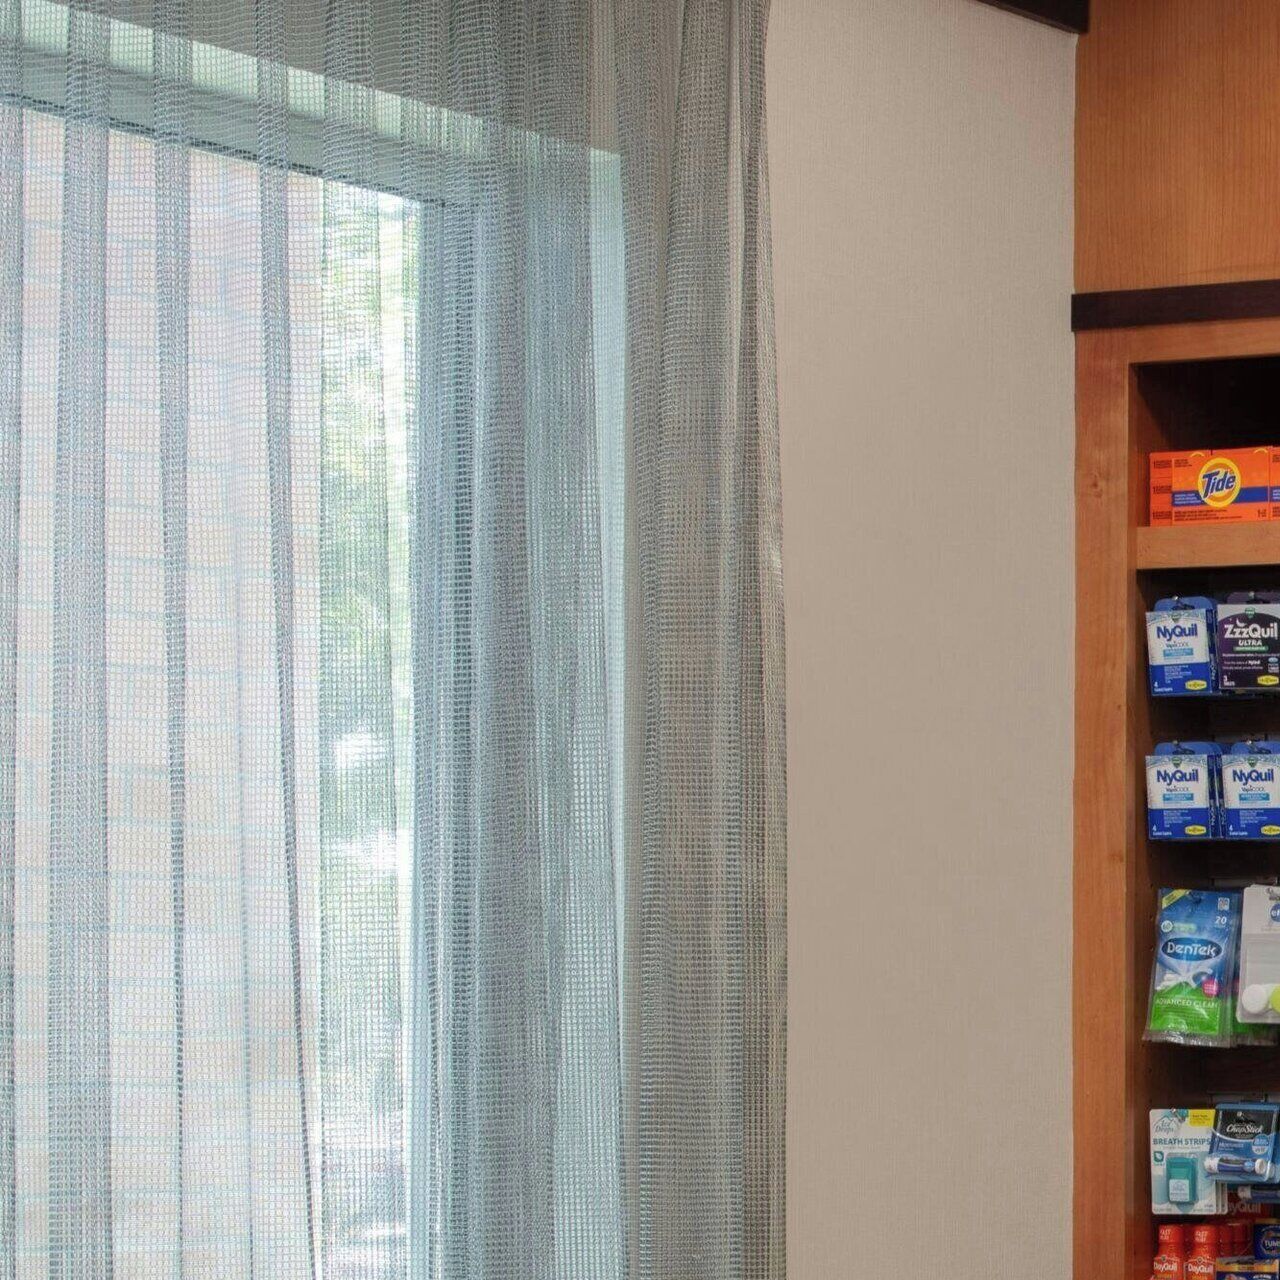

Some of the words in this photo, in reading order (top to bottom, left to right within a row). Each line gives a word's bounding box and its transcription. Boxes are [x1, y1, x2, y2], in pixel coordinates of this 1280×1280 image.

[1202, 468, 1236, 499] Tide
[1157, 624, 1198, 641] NyQuil
[1224, 621, 1278, 640] ZzzQuil
[1157, 769, 1199, 785] NyQuil
[1232, 769, 1274, 785] NyQuil
[1215, 916, 1227, 926] 20
[1167, 942, 1217, 956] DenTek
[1226, 1124, 1263, 1134] ChapStick
[1188, 1262, 1213, 1273] DayQuil
